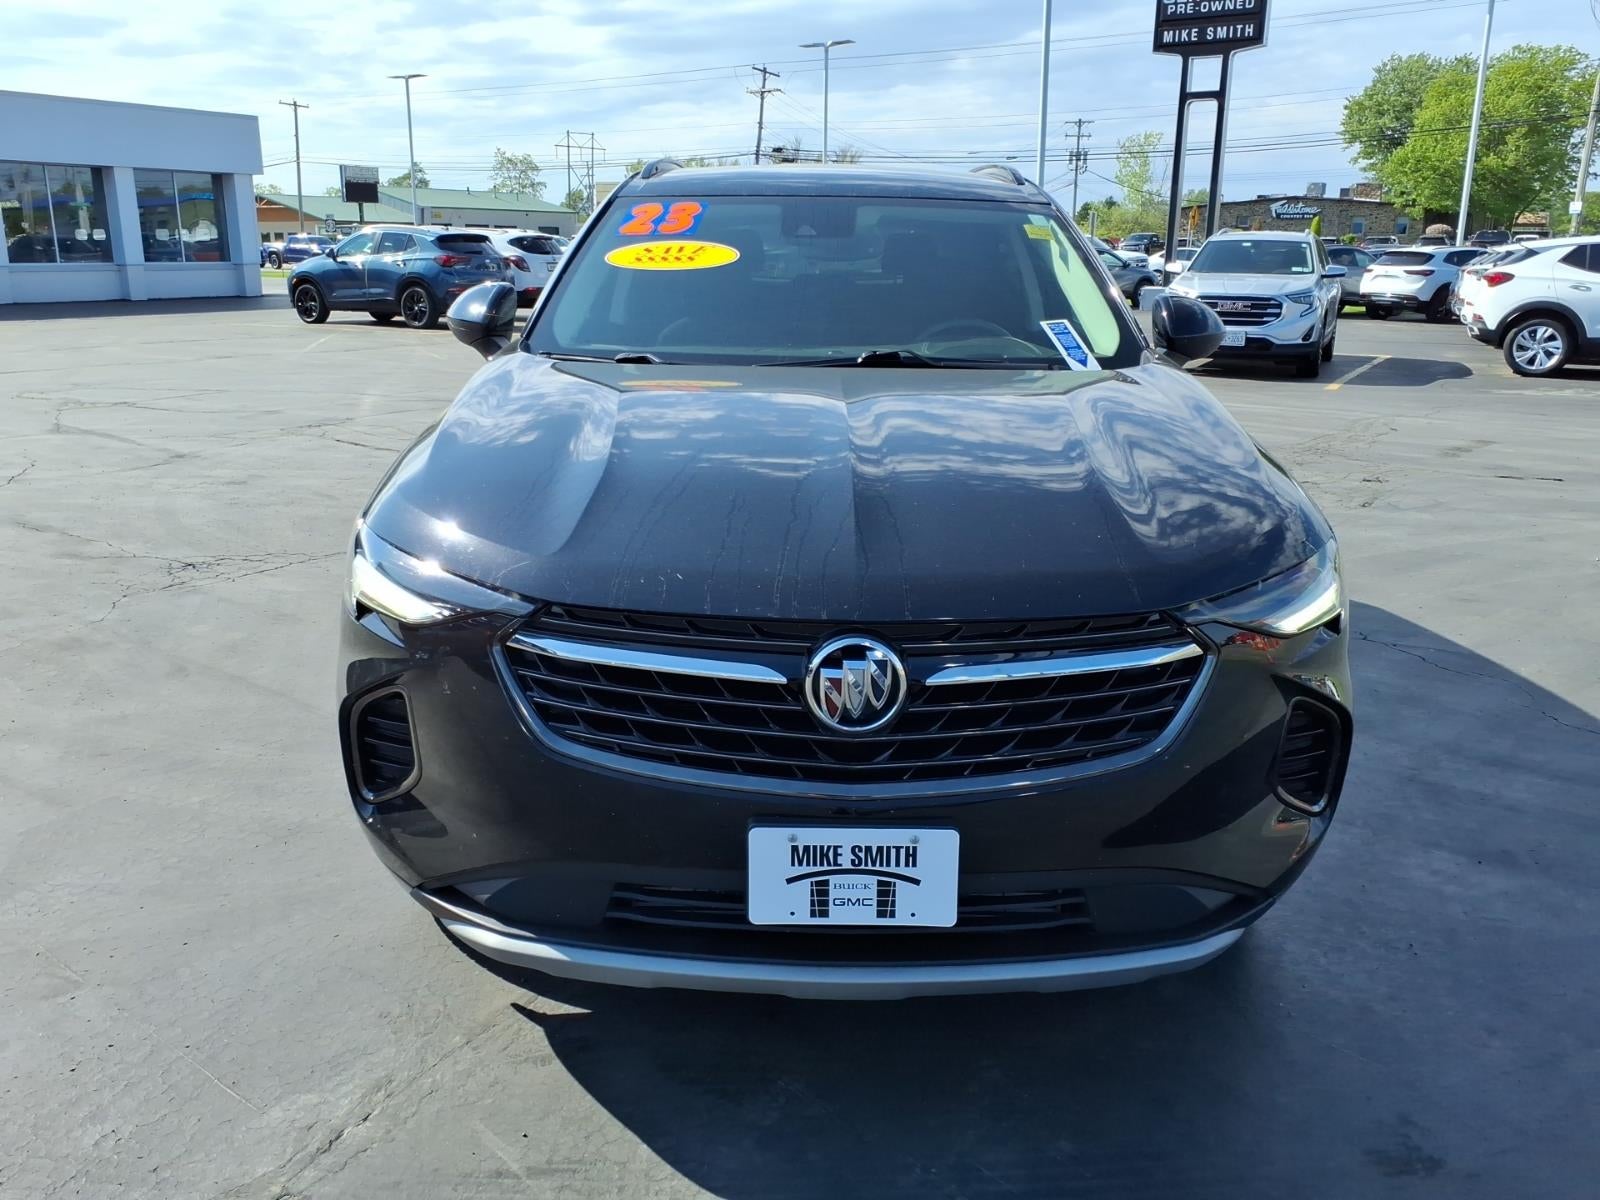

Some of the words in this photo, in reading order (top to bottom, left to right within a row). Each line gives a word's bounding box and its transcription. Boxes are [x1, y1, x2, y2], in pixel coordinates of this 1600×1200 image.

[1167, 0, 1255, 15] PRE-OWNED
[1163, 28, 1198, 43] MIKE
[1206, 23, 1254, 40] SMITH
[619, 202, 702, 235] 23
[1218, 302, 1251, 311] GMC
[790, 844, 843, 867] MIKE
[850, 844, 918, 868] SMITH
[832, 898, 874, 907] GMC
